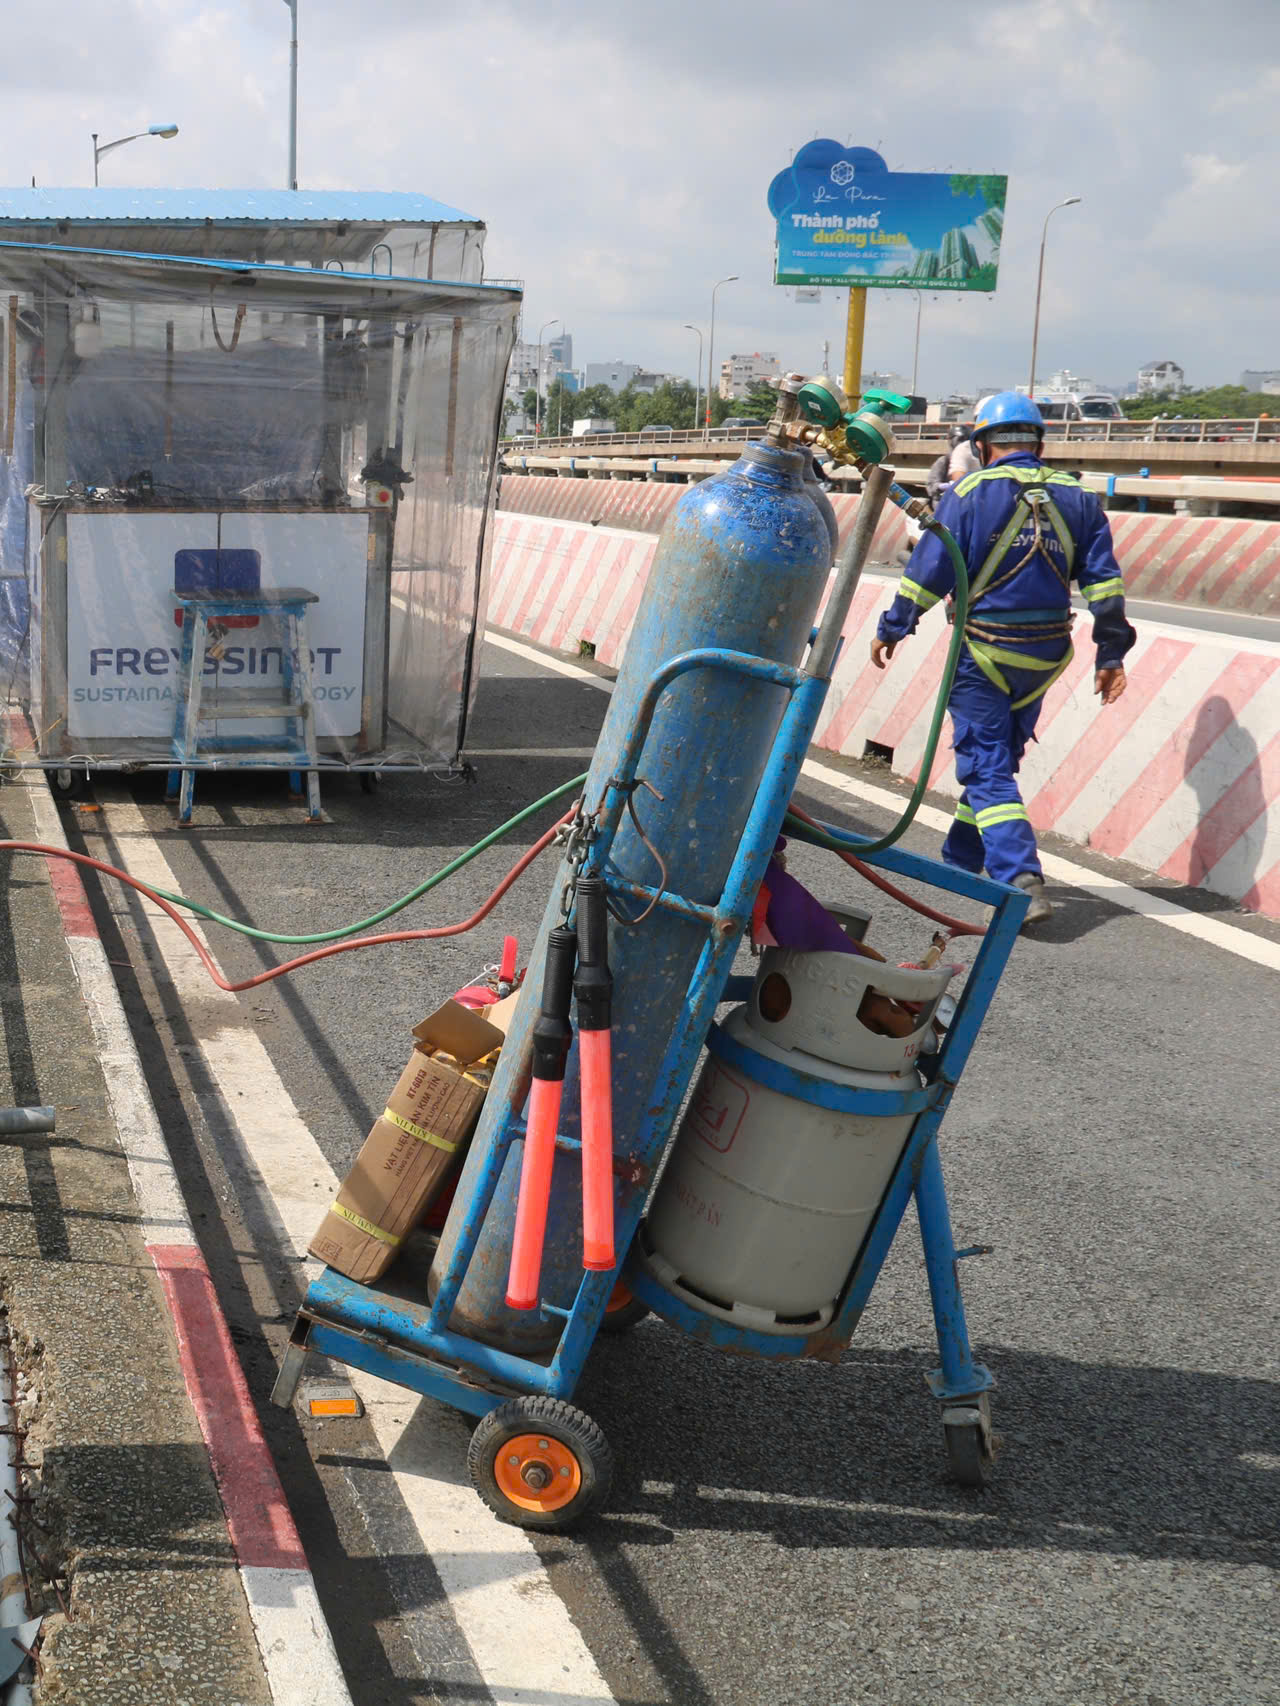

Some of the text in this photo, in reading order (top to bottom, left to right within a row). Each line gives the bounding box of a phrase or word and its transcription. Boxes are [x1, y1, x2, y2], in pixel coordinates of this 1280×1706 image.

[792, 210, 881, 230] Thành phố
[406, 1069, 427, 1099] KT-6013
[419, 1093, 431, 1110] KIM
